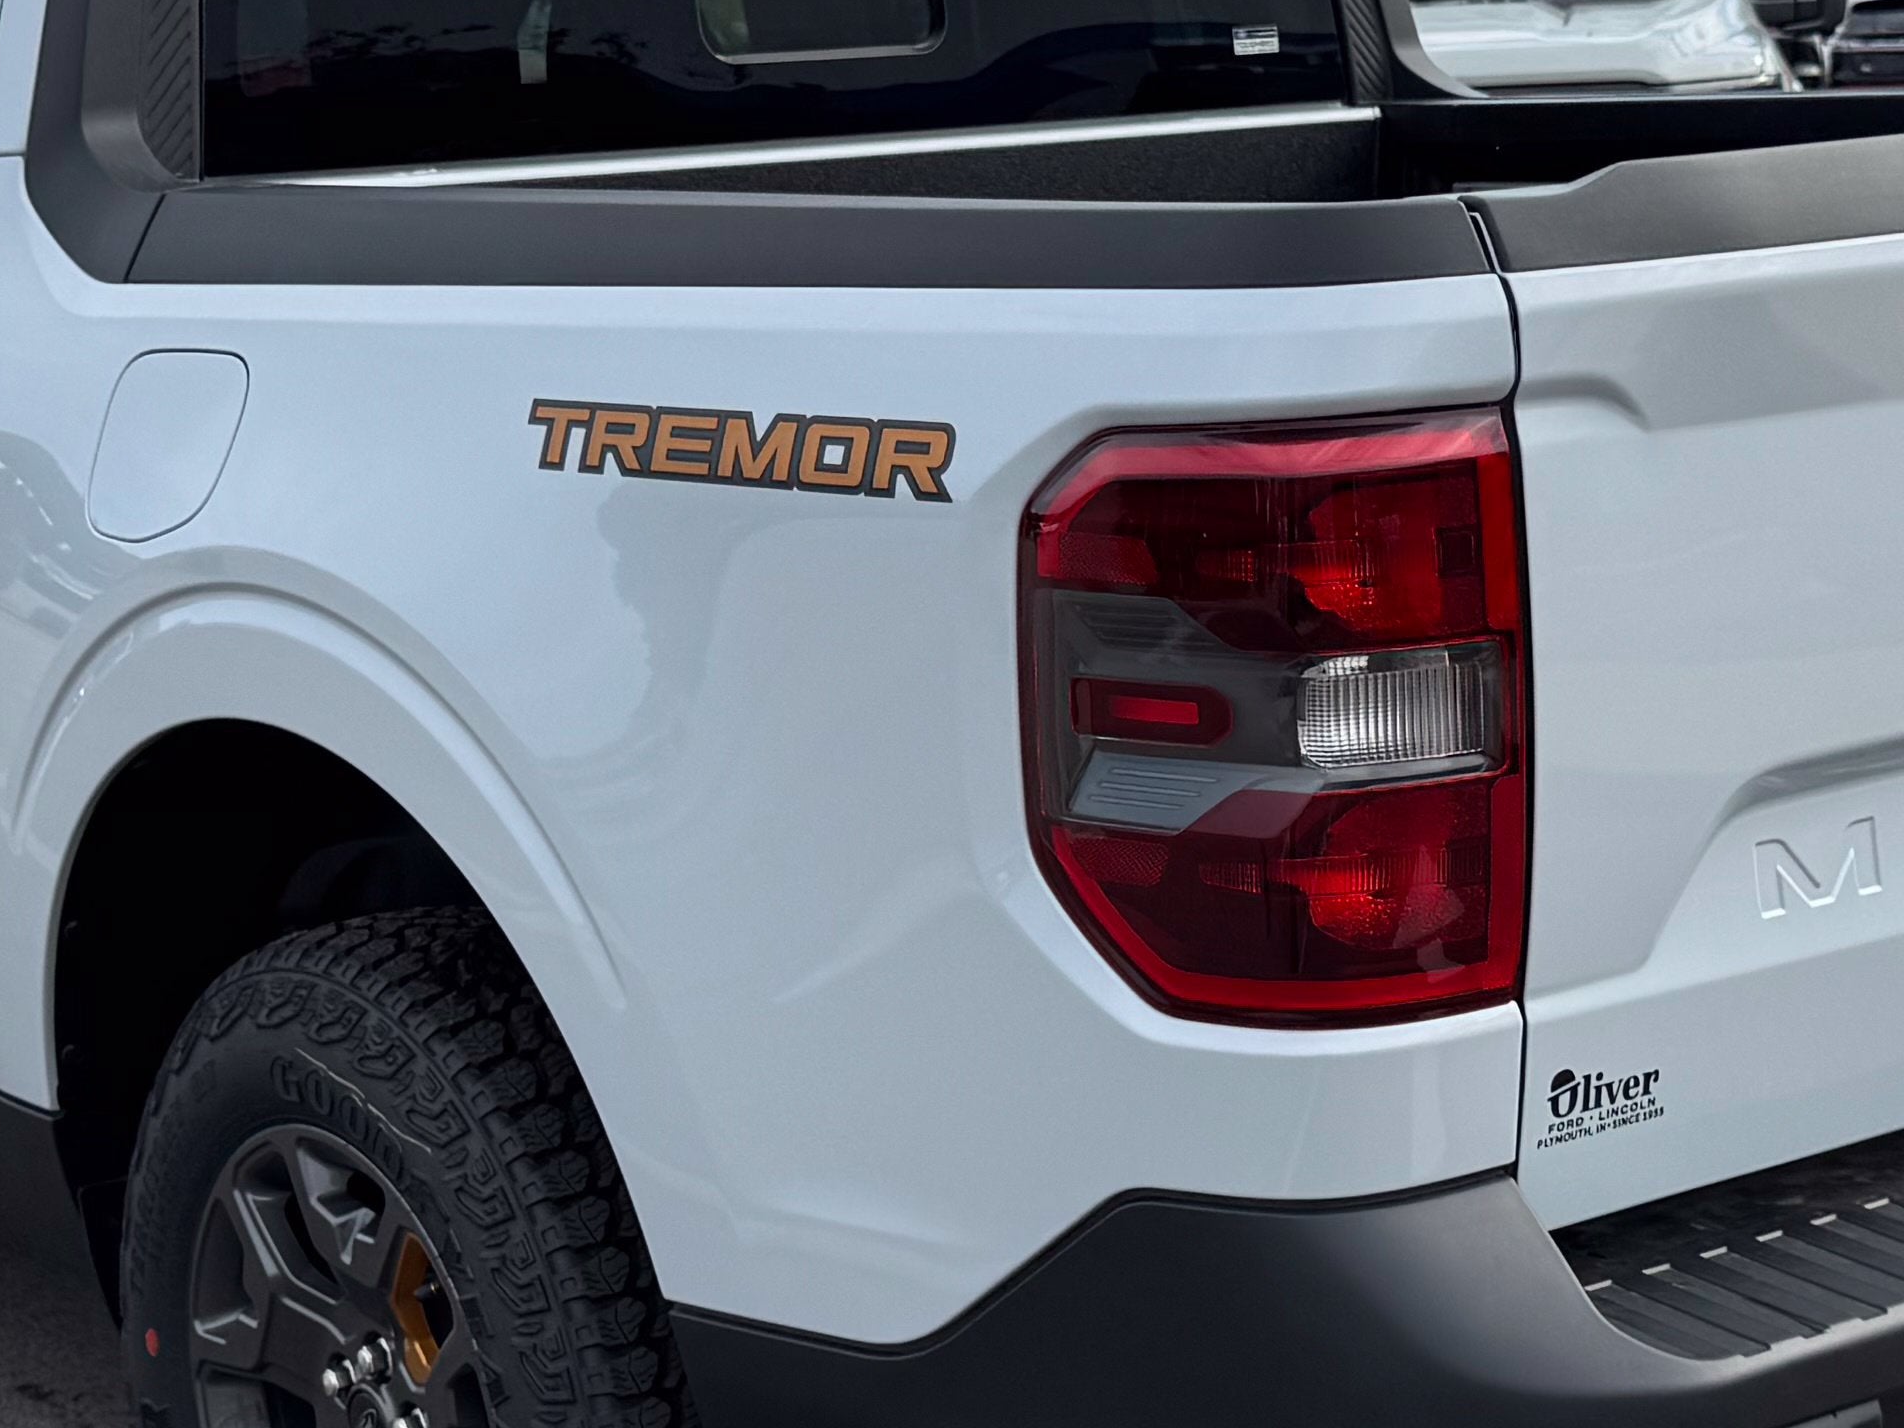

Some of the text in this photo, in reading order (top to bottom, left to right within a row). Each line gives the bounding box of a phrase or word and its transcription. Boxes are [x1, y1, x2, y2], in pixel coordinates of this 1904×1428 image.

[528, 398, 956, 503] TREMOR
[1546, 1068, 1660, 1119] Oliver
[1548, 1096, 1656, 1134] FORD LINCOLN
